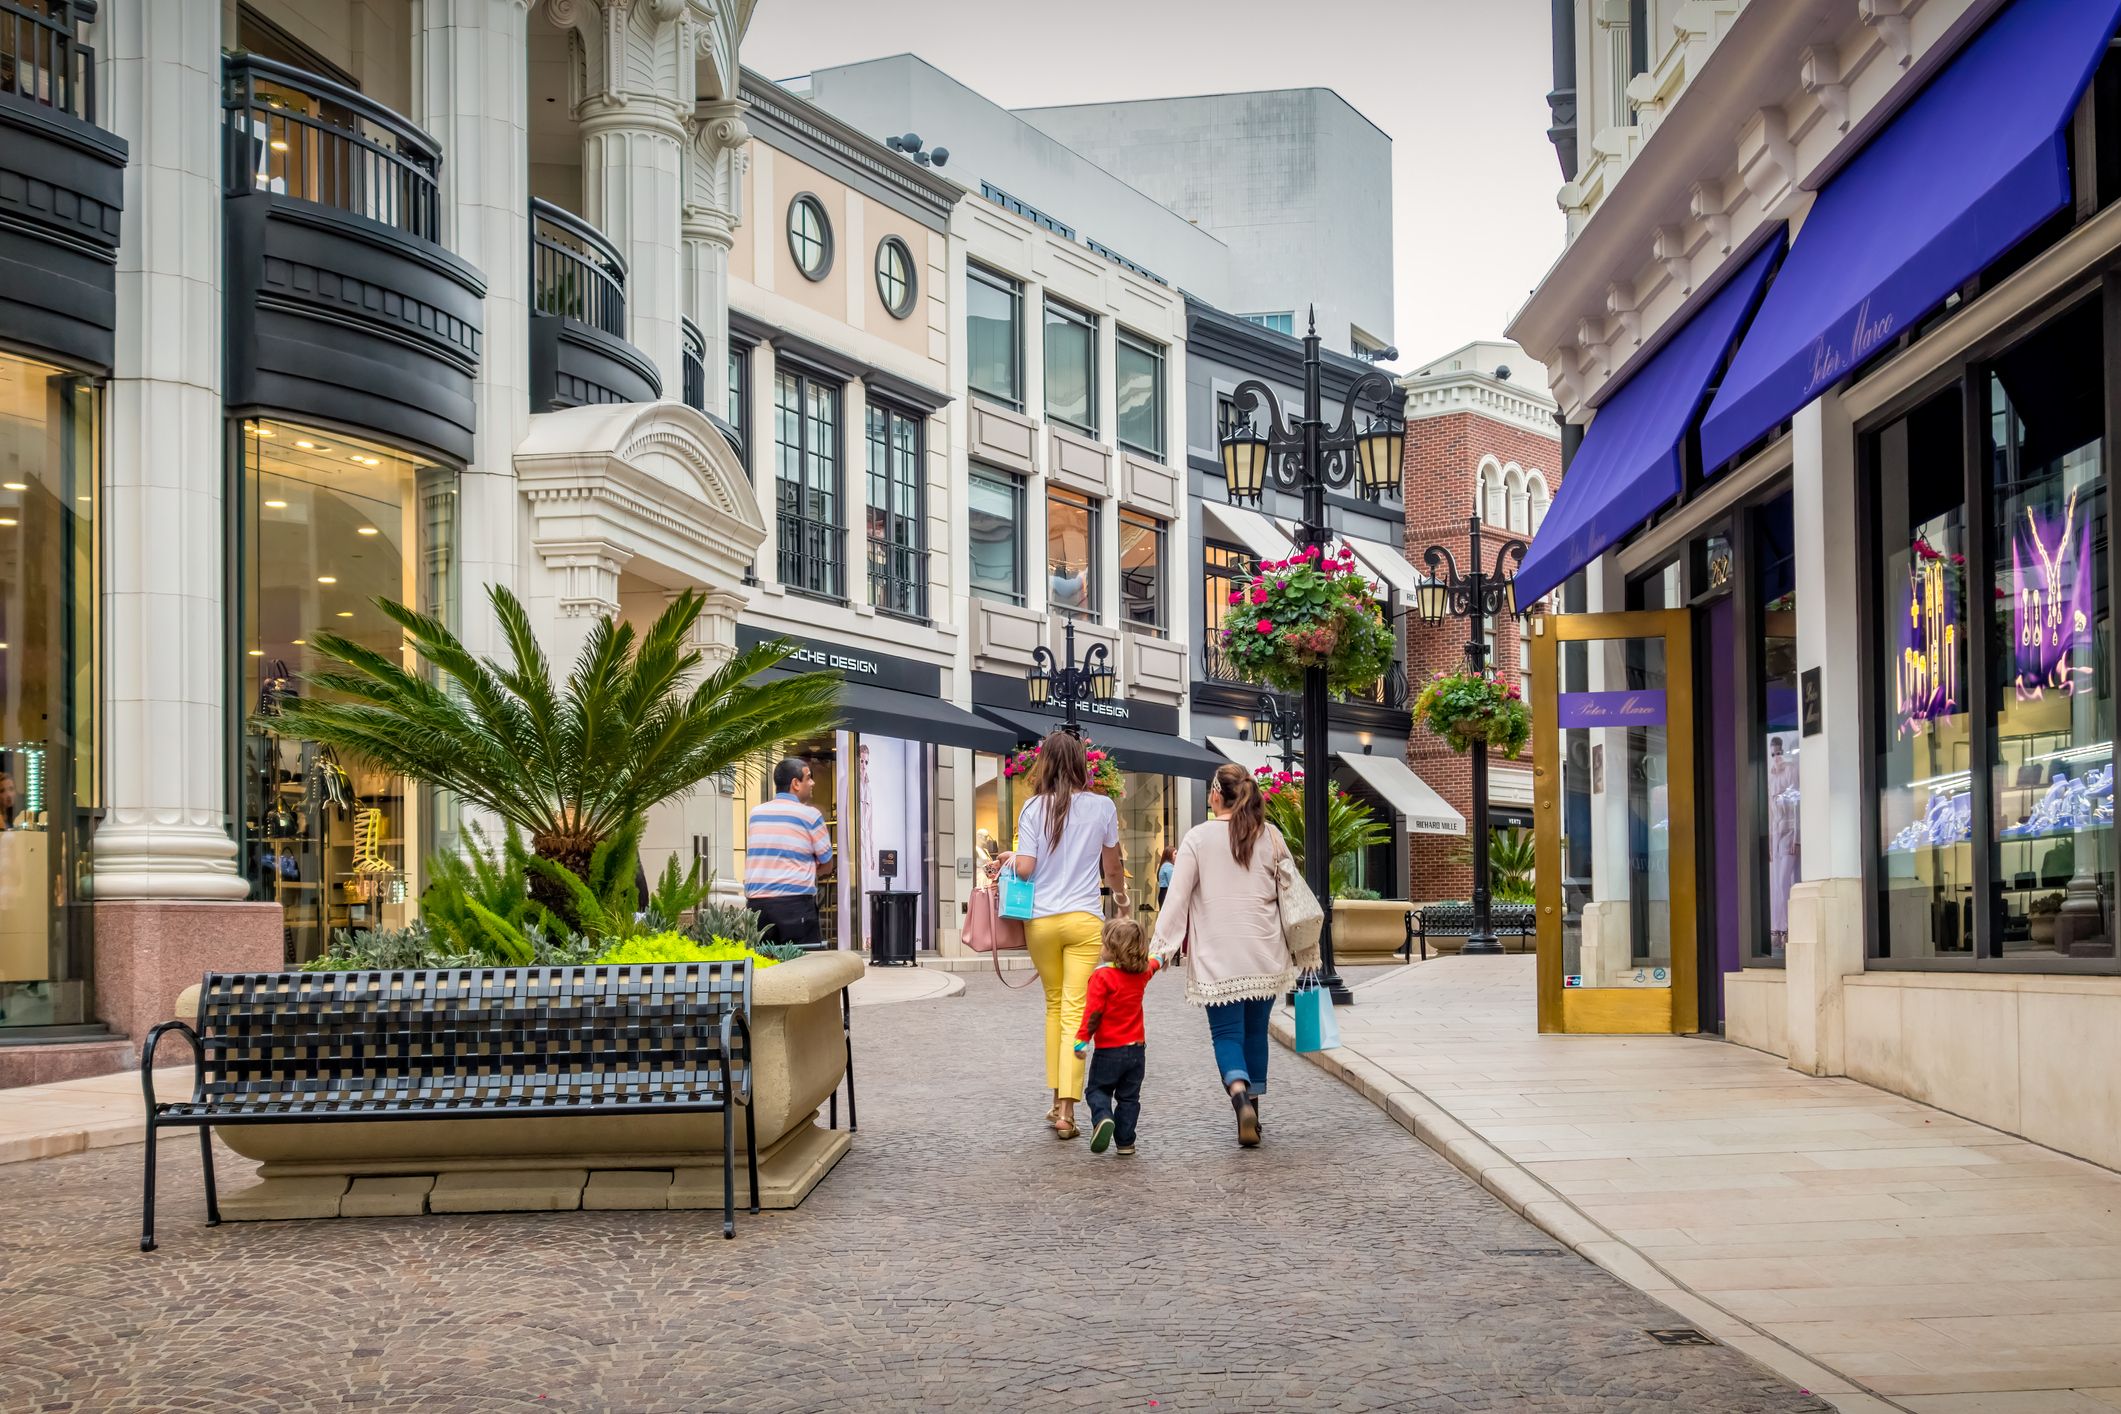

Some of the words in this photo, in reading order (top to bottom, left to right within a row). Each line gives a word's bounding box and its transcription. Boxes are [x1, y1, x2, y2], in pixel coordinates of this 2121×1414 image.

[1804, 334, 1840, 394] Peter
[1843, 297, 1894, 368] Marco
[829, 654, 878, 675] DESIGN
[1092, 703, 1129, 719] DESIGN
[1416, 820, 1441, 830] RICHARD
[355, 880, 409, 898] VERSAE
